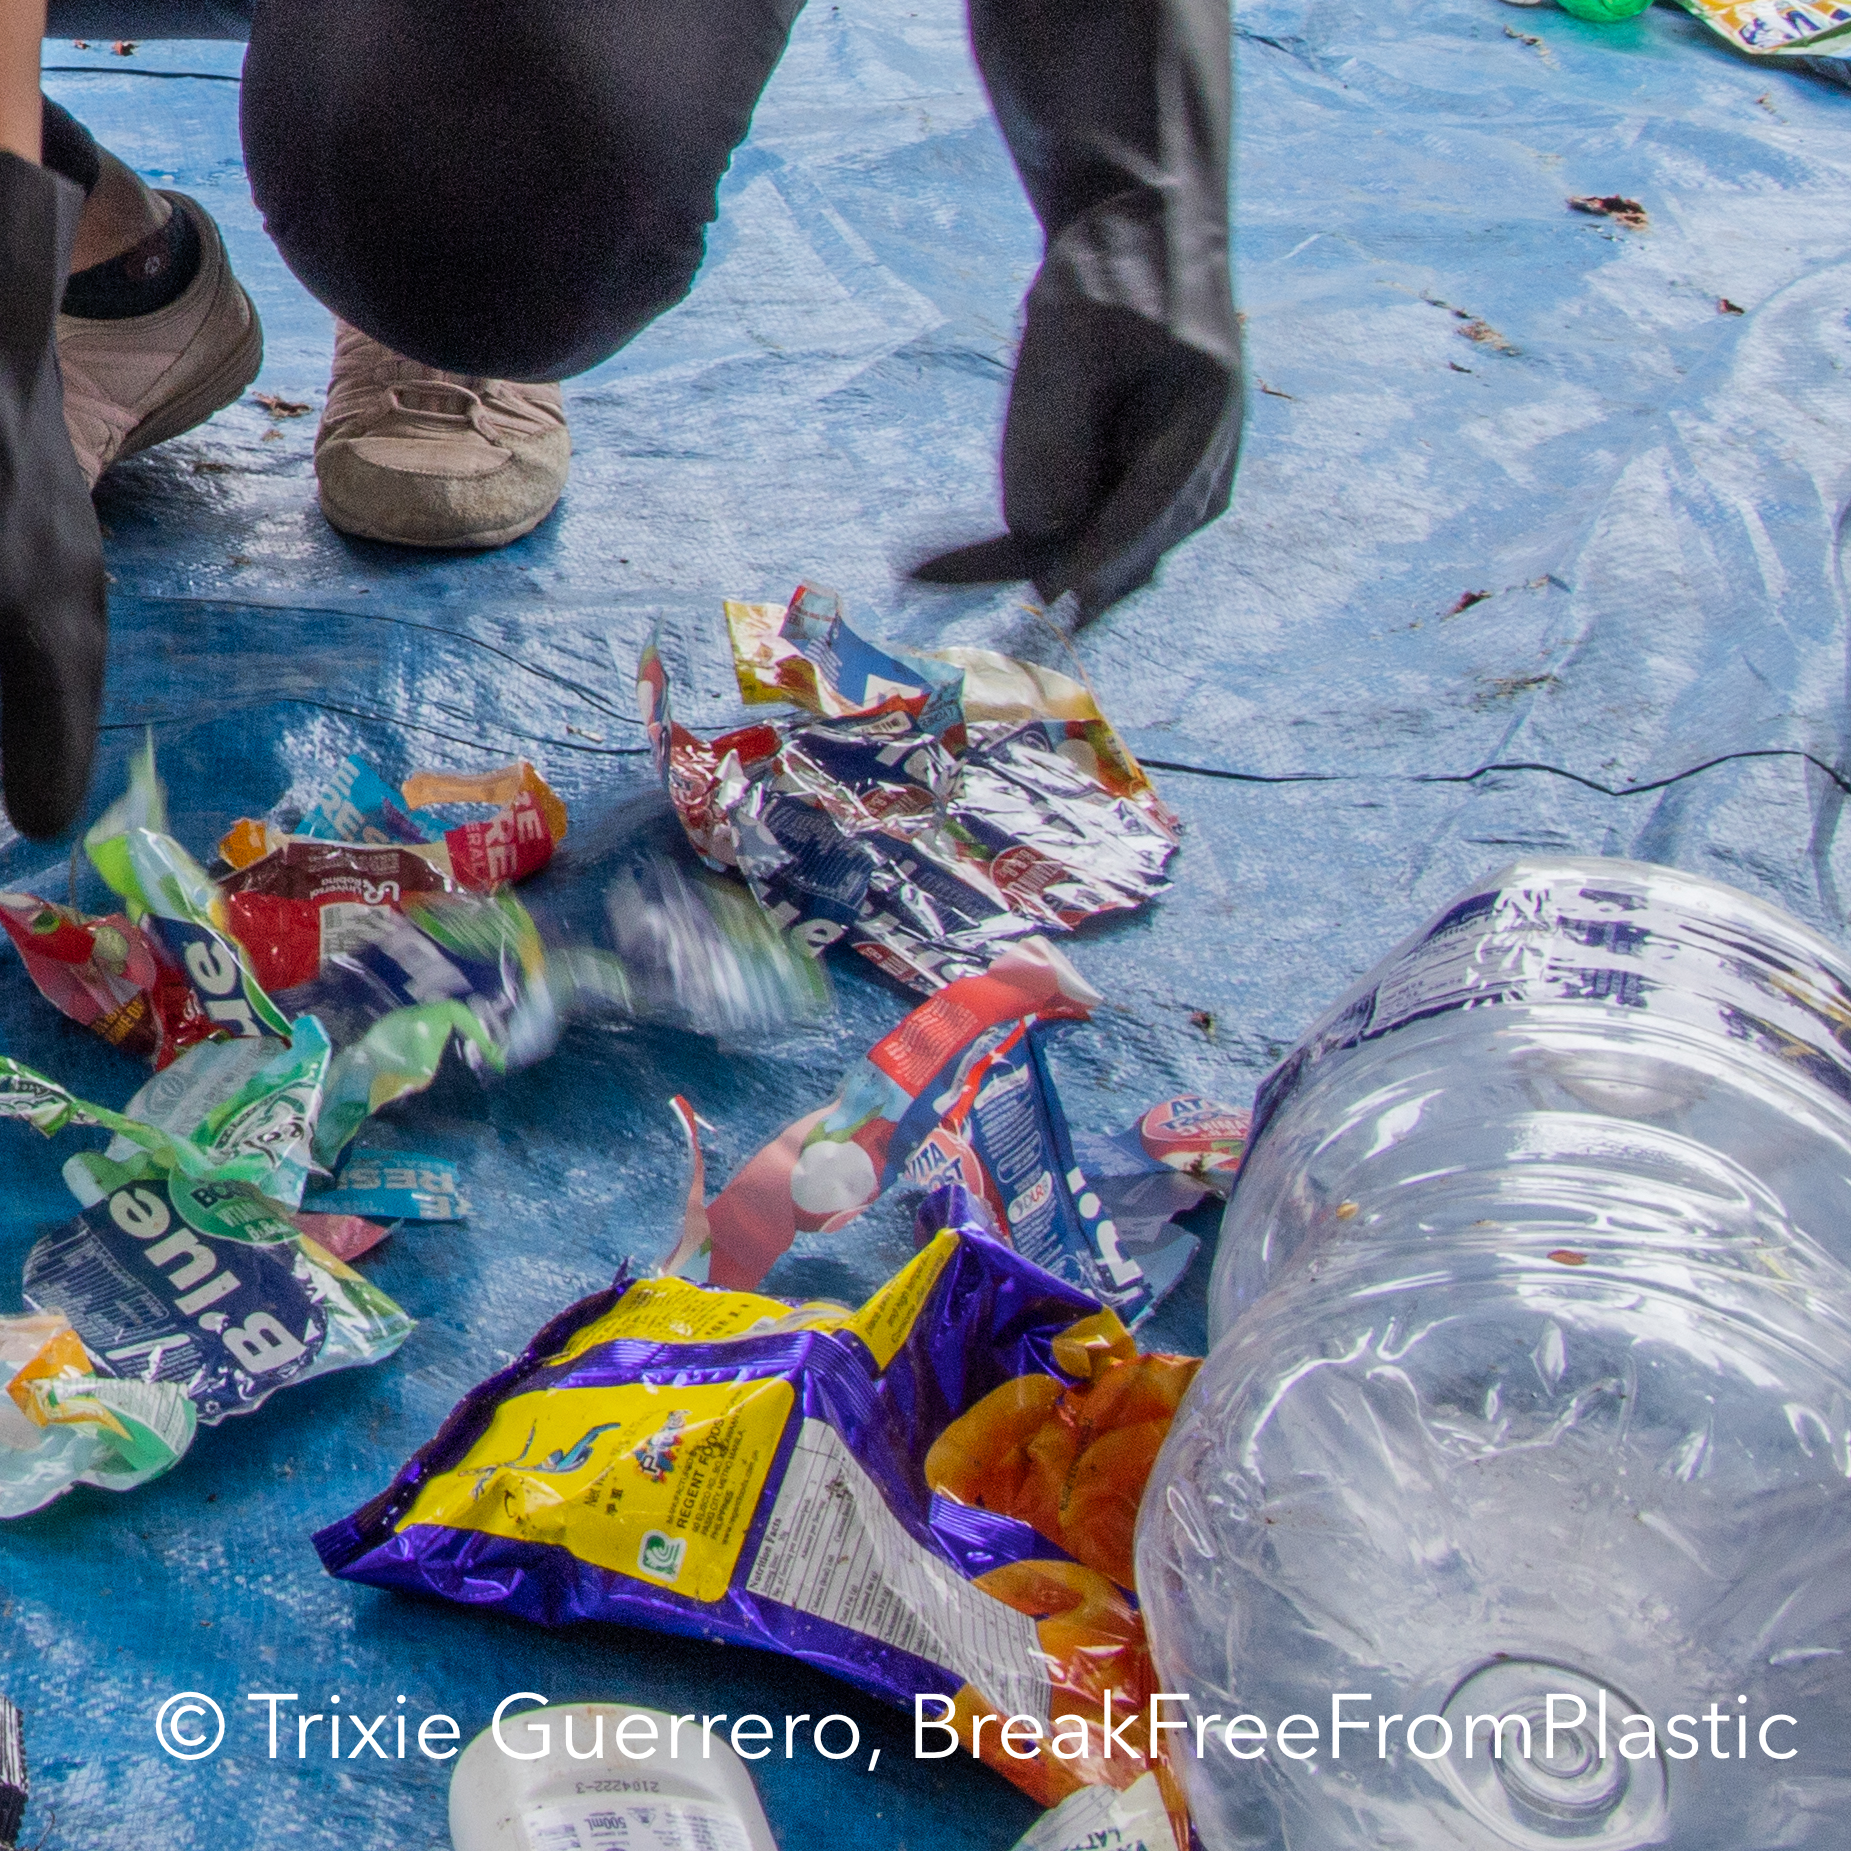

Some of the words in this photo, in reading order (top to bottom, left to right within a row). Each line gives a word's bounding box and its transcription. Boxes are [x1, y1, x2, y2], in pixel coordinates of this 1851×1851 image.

[109, 1183, 301, 1373] B'lue
[677, 1470, 705, 1530] REGENT
[748, 1537, 774, 1591] Nutrition
[765, 1517, 783, 1546] Facts
